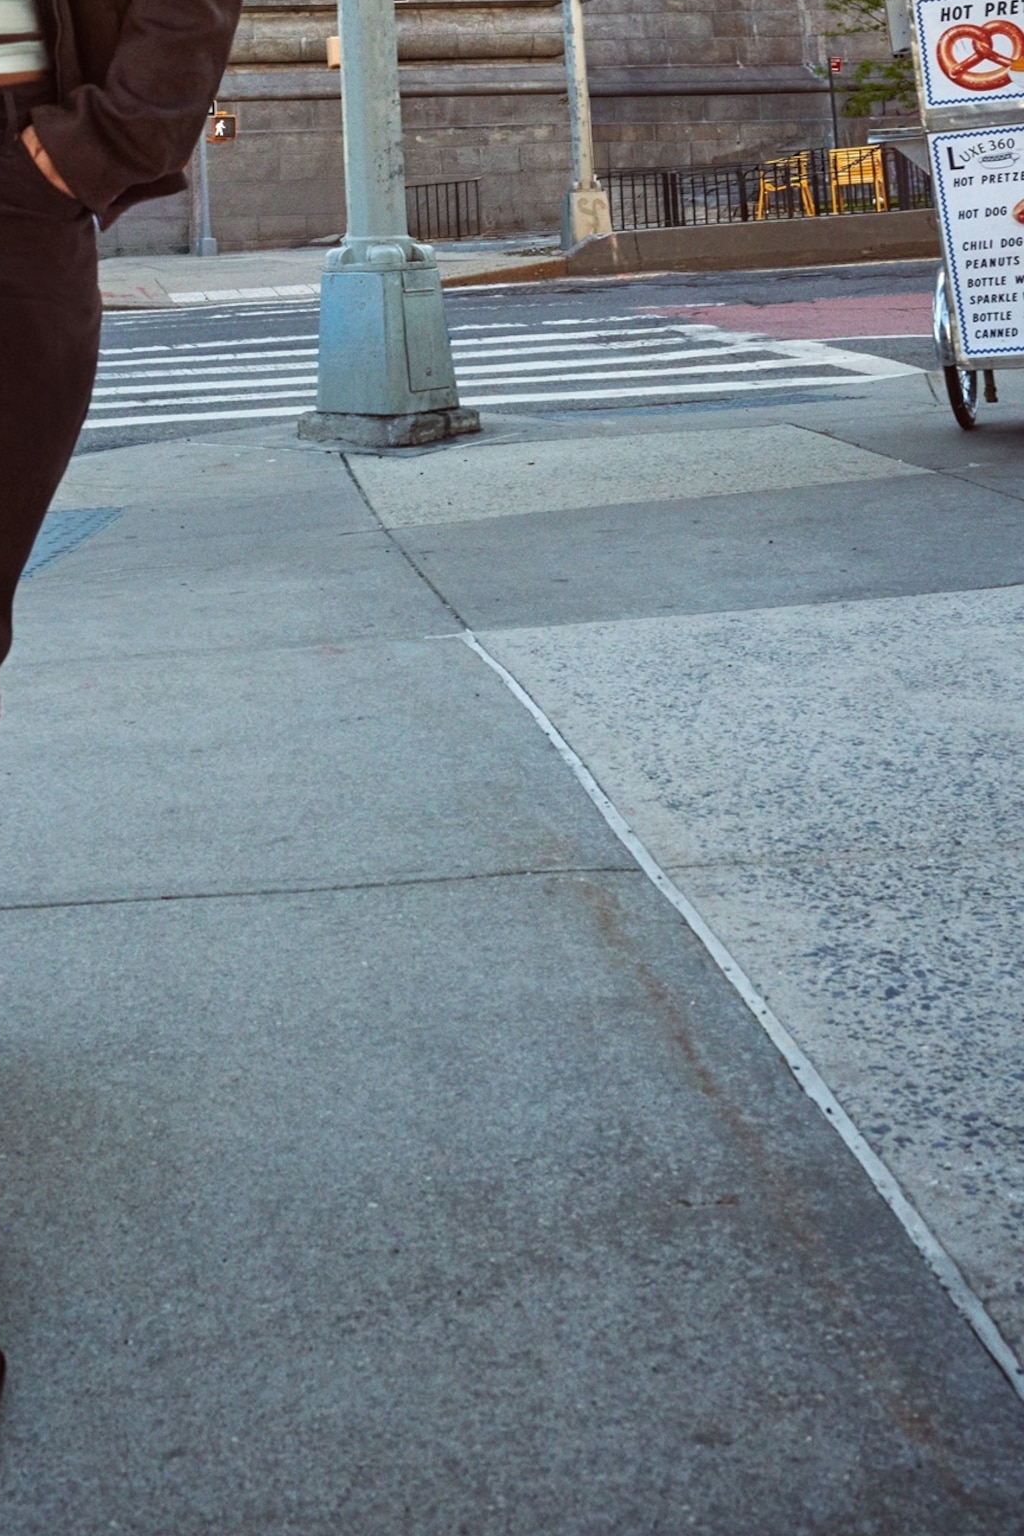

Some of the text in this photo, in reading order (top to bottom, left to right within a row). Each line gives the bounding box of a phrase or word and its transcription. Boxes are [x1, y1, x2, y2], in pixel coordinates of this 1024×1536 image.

[940, 4, 974, 22] HOT
[946, 137, 1016, 171] LUXE 360
[953, 176, 974, 188] HOT
[958, 206, 1008, 220] HOT DOG
[962, 236, 1023, 252] CHILI DOG
[965, 255, 1020, 270] PEANUTS
[967, 275, 1007, 289] BOTTLE
[969, 292, 1018, 305] SPARKLE
[972, 310, 1012, 323] BOTTLE
[974, 327, 1019, 340] CANNED
